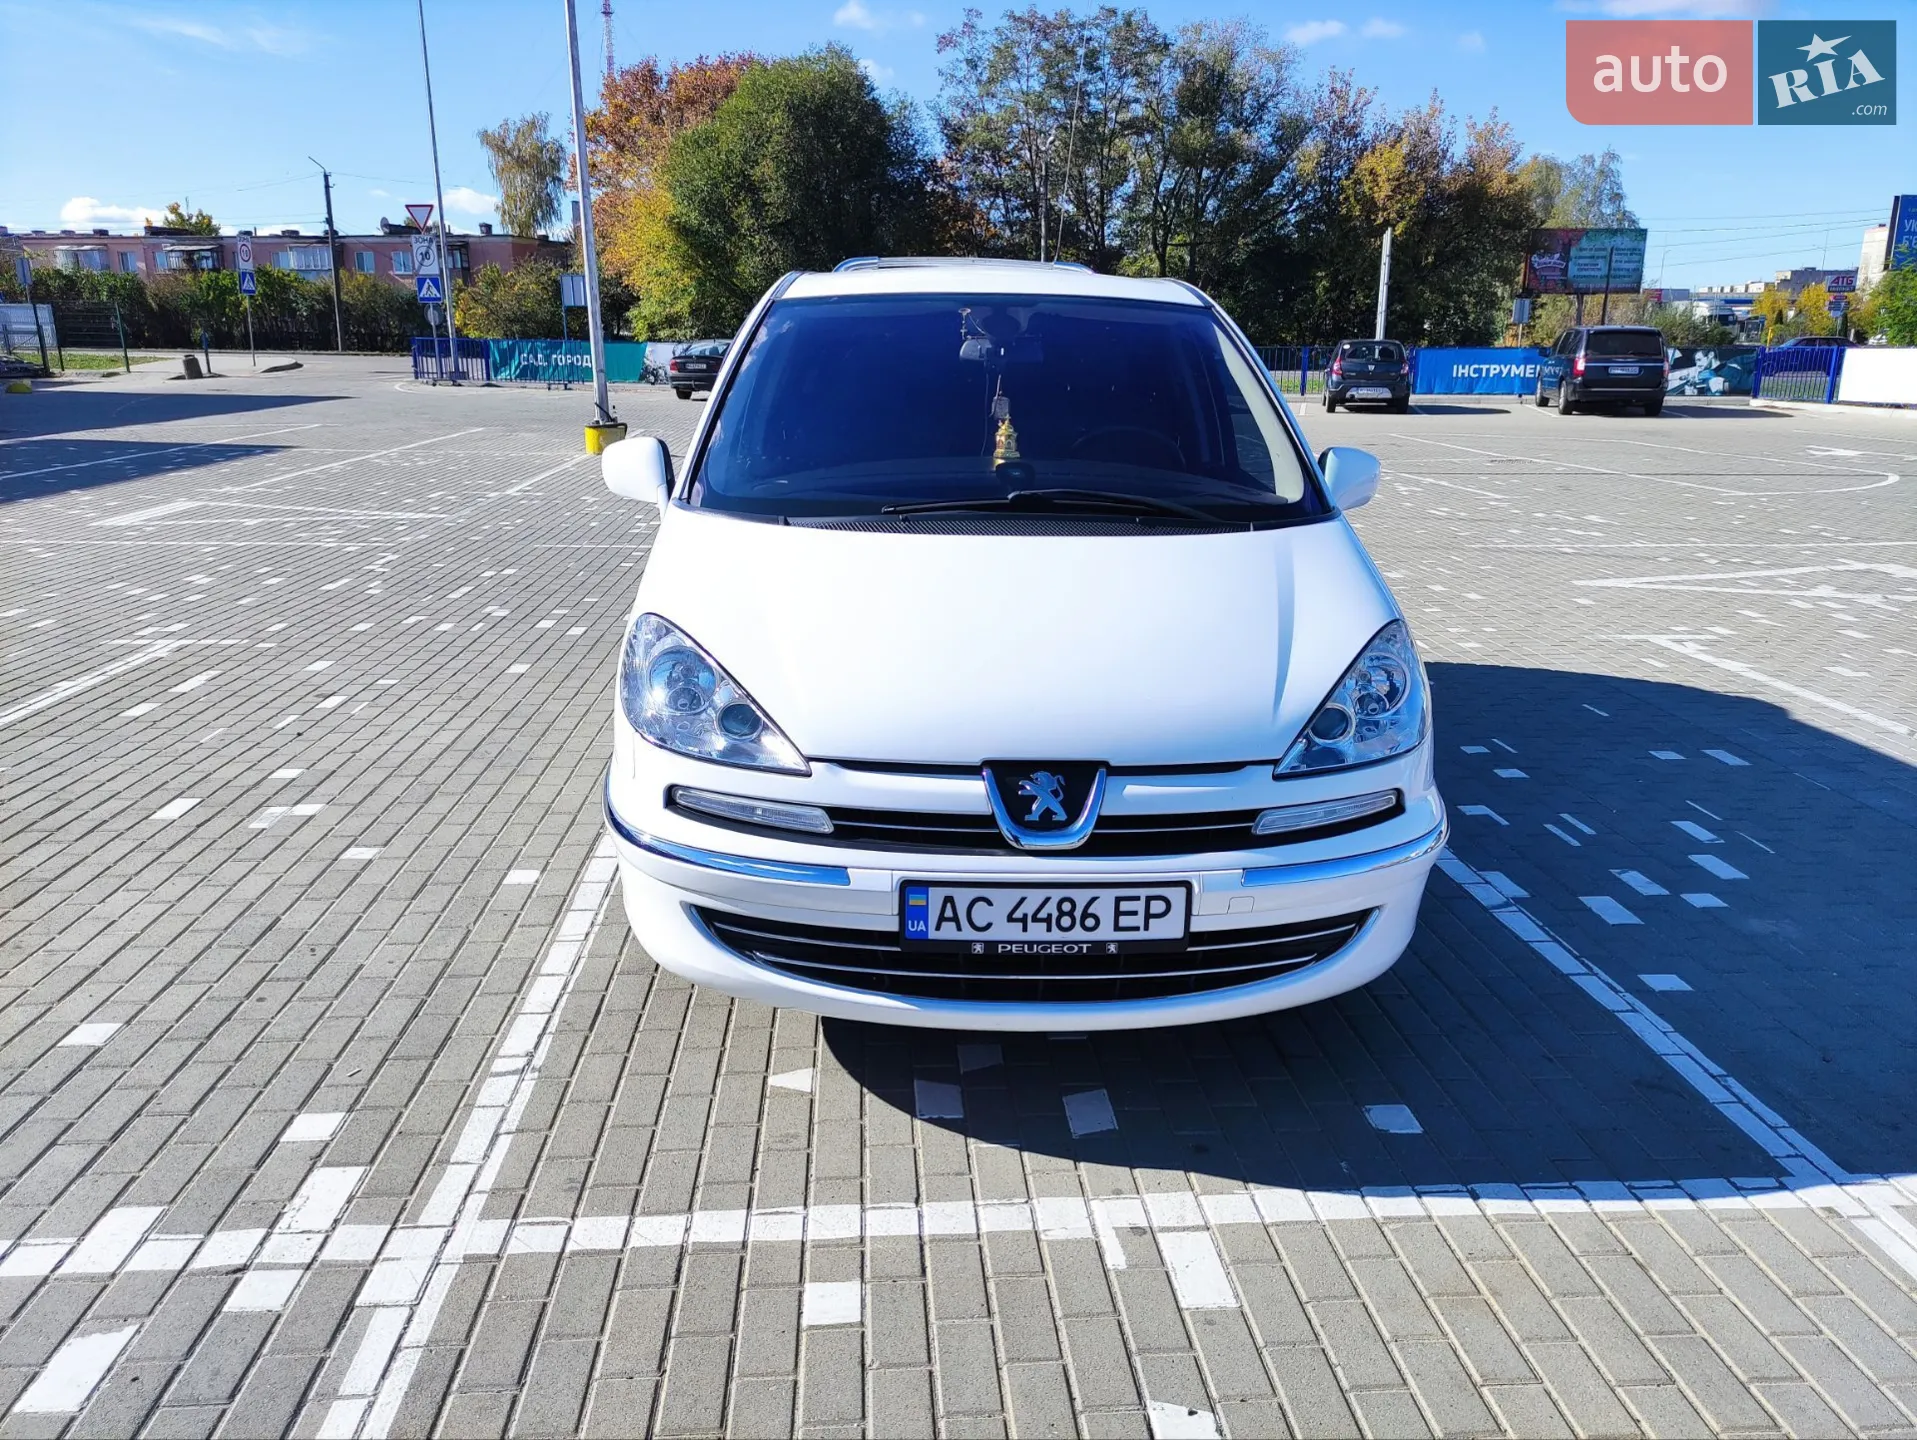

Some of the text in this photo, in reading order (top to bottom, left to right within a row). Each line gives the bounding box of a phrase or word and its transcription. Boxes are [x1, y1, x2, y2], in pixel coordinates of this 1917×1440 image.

[419, 251, 431, 261] 10
[552, 354, 591, 368] ГОРОД
[934, 894, 1172, 933] AC 4486 EP
[908, 920, 926, 932] UA
[997, 943, 1092, 954] PEUGEOT
